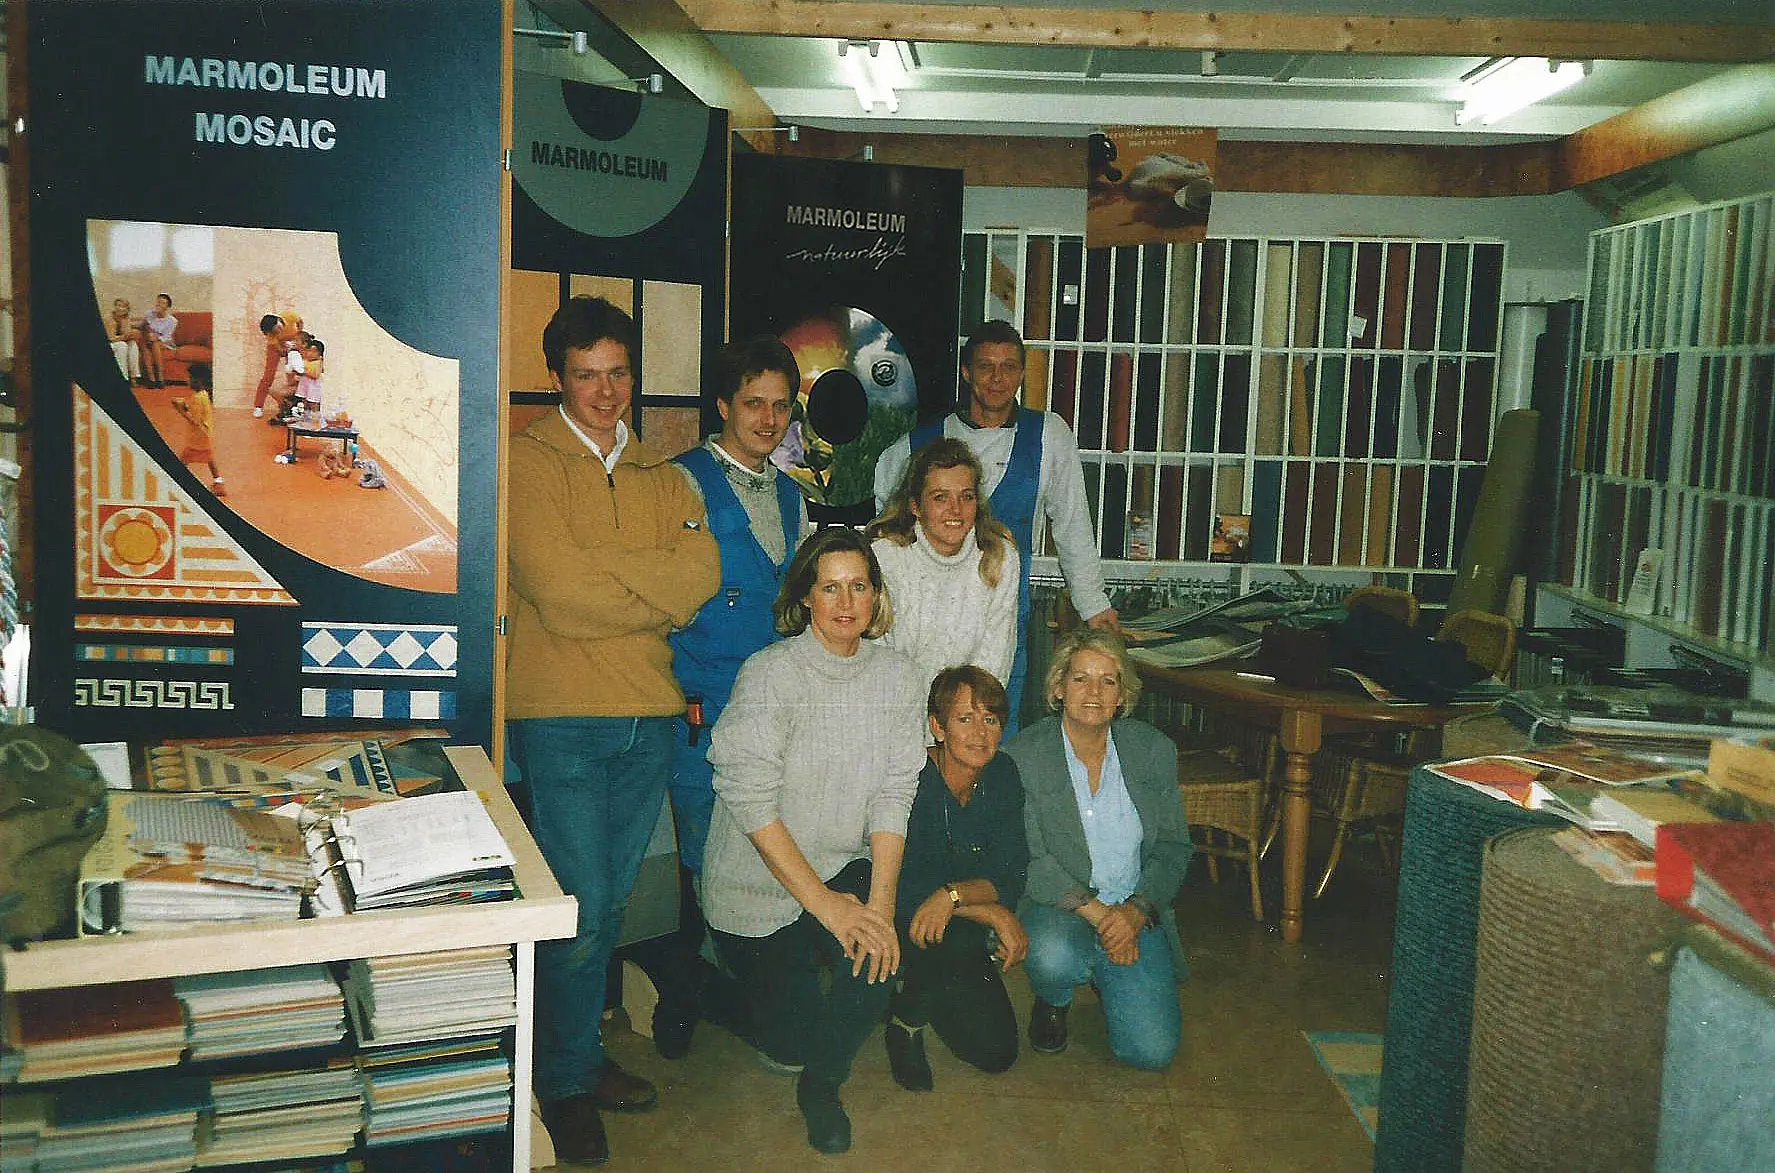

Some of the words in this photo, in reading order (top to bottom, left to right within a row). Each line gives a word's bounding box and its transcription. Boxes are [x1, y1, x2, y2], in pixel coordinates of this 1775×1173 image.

[144, 55, 386, 99] MARMOLEUM
[195, 112, 336, 151] MOSAIC
[531, 140, 668, 182] MARMOLEUM
[786, 205, 906, 233] MARMOLEUM
